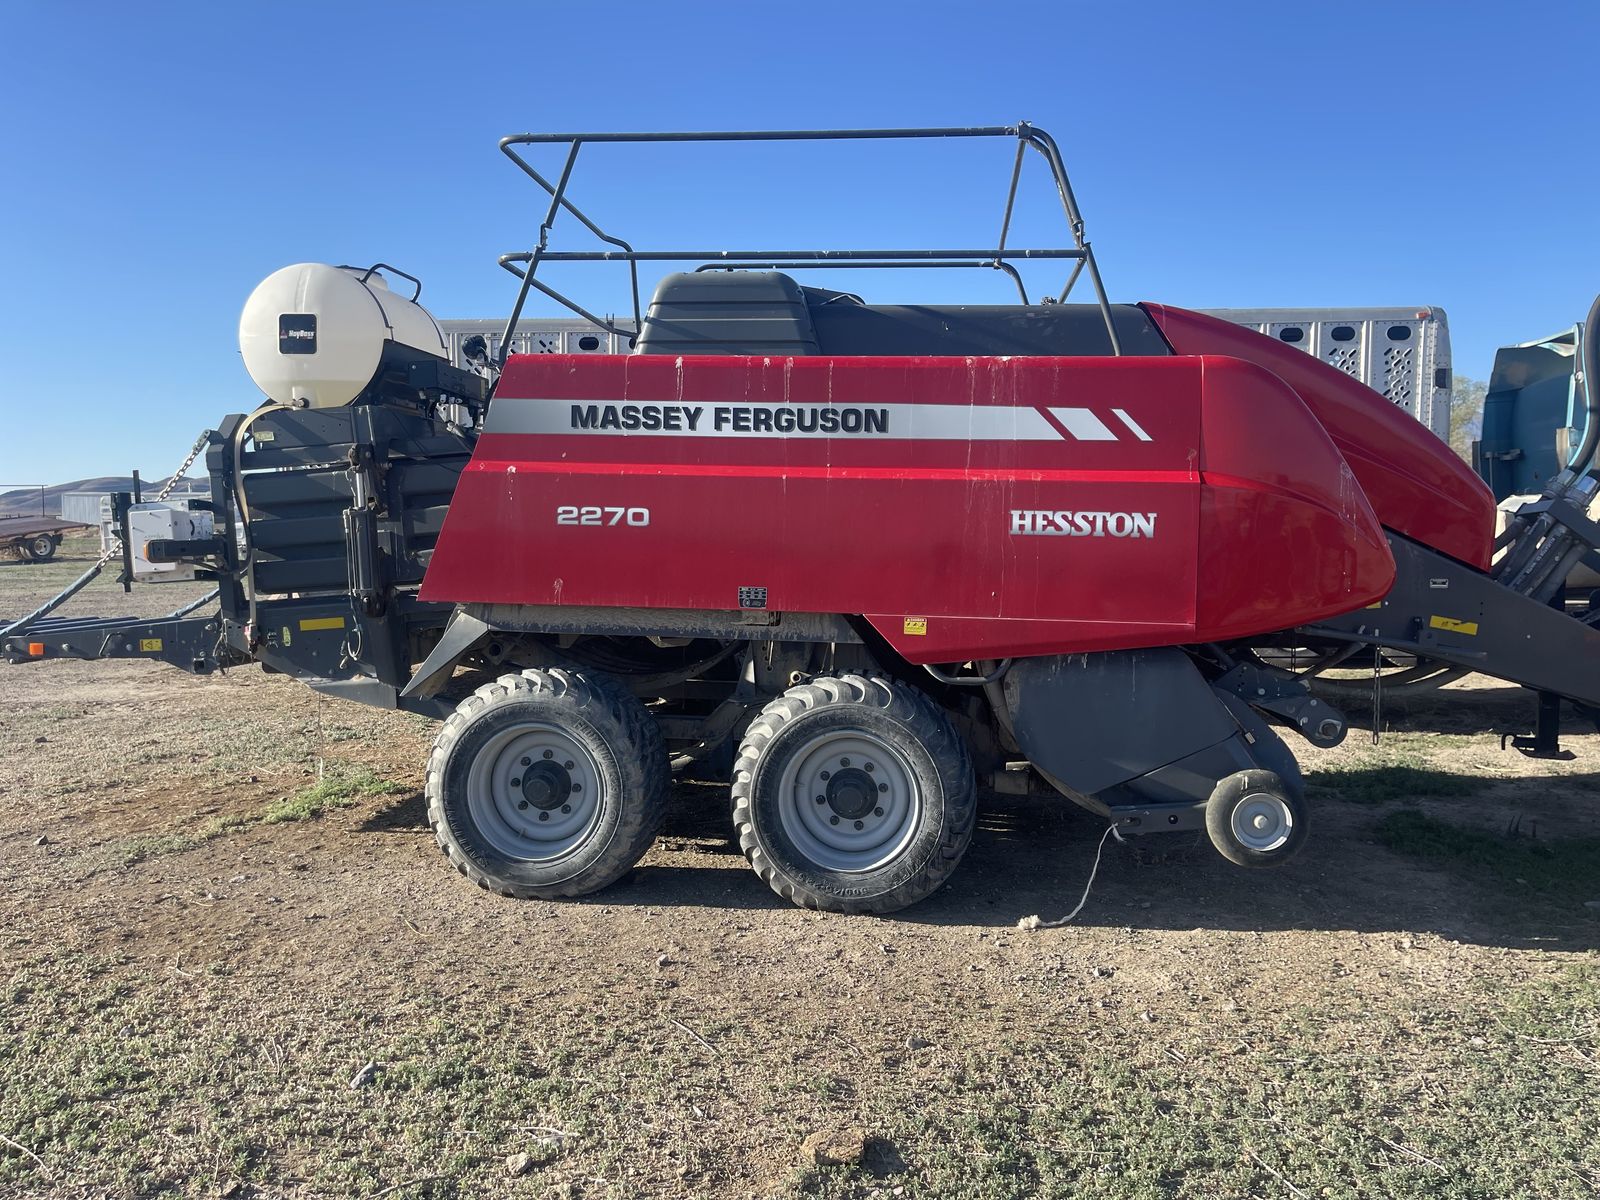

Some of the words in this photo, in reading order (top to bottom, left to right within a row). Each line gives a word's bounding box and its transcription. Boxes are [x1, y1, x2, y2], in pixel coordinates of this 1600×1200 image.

[570, 404, 704, 431] MASSEY
[713, 407, 890, 434] FERGUSON
[557, 506, 650, 526] 2270
[1010, 510, 1158, 538] HESSTON
